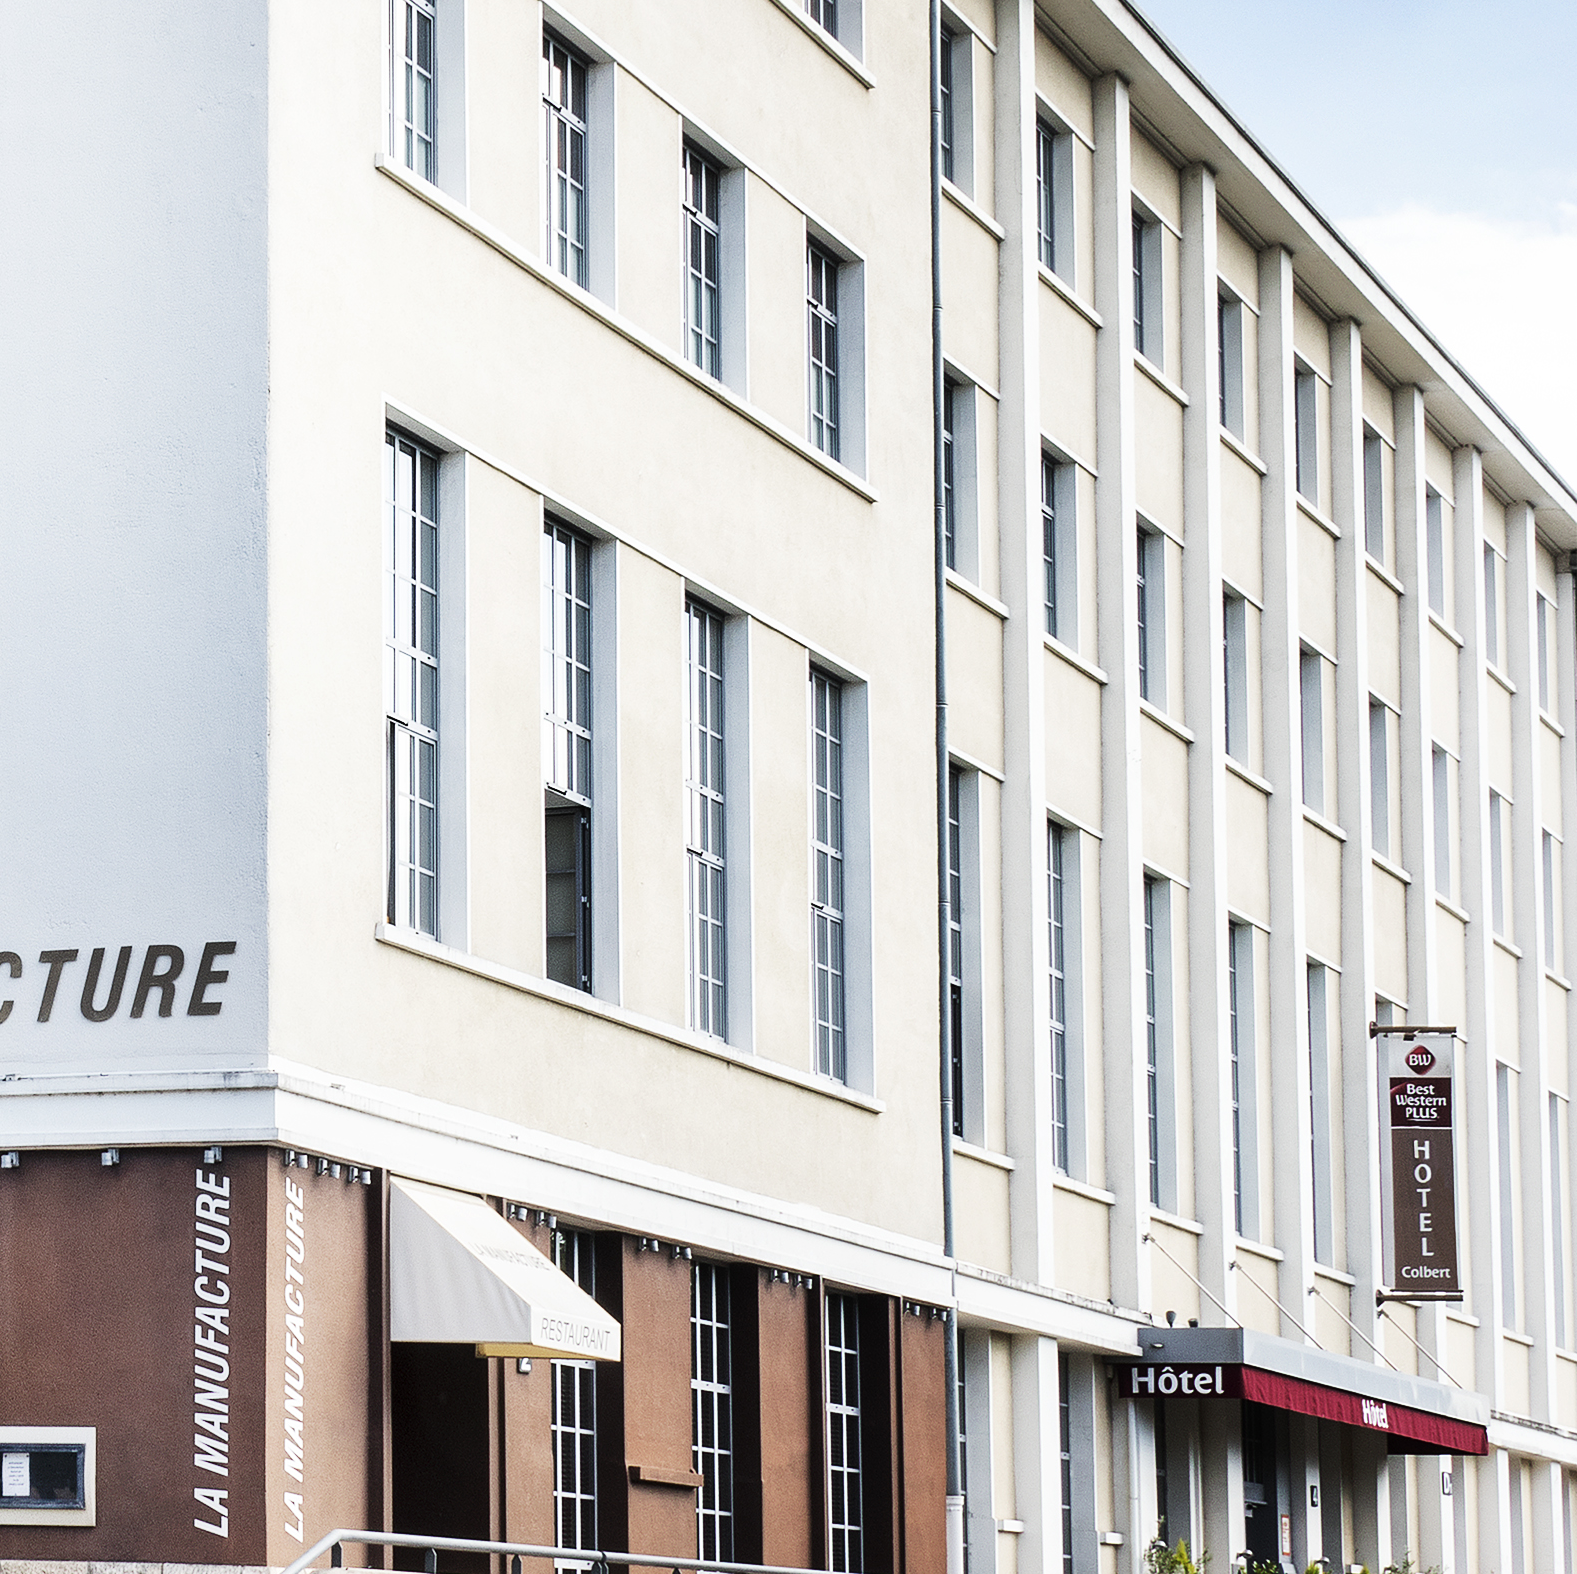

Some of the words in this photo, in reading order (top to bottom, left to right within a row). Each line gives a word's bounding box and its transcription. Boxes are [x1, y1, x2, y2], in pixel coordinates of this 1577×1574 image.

[1409, 1053, 1432, 1066] BW
[1395, 1095, 1447, 1106] Western
[1406, 1083, 1435, 1095] Best
[1405, 1107, 1438, 1119] PLUS
[1413, 1140, 1435, 1257] HOTEL
[1401, 1266, 1451, 1279] Colbert
[194, 1169, 231, 1477] MANUFACTURE
[284, 1177, 305, 1482] MANUFACTURE
[540, 1317, 611, 1352] RESTAURANT
[1131, 1365, 1224, 1395] Hôtel
[1361, 1398, 1390, 1429] Hôtel
[194, 1486, 229, 1538] LA
[284, 1491, 305, 1543] LA
